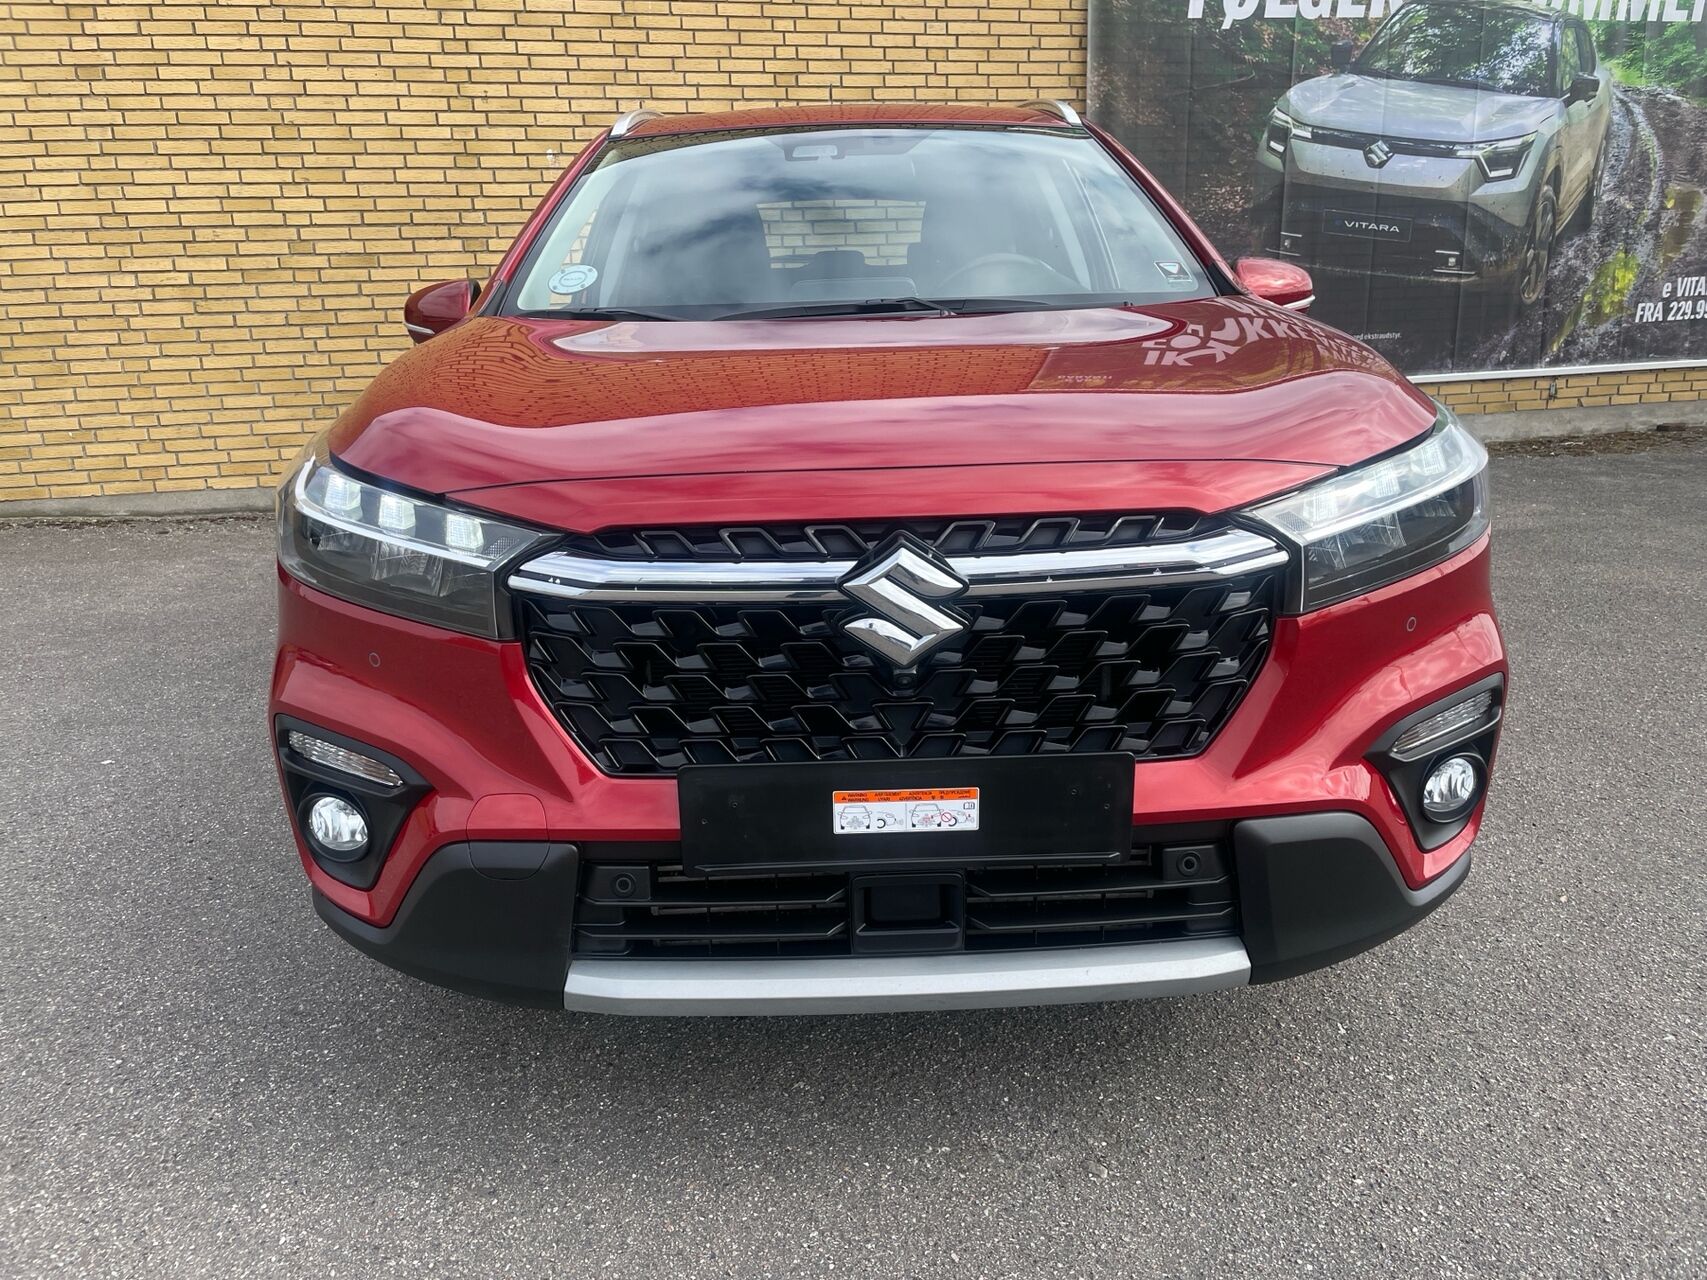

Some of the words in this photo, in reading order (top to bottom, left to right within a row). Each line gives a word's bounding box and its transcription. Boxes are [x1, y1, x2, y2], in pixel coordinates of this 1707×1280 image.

[1344, 220, 1400, 233] VITARA
[1662, 282, 1672, 298] e
[1677, 276, 1707, 297] VITA
[1635, 302, 1664, 323] FRA
